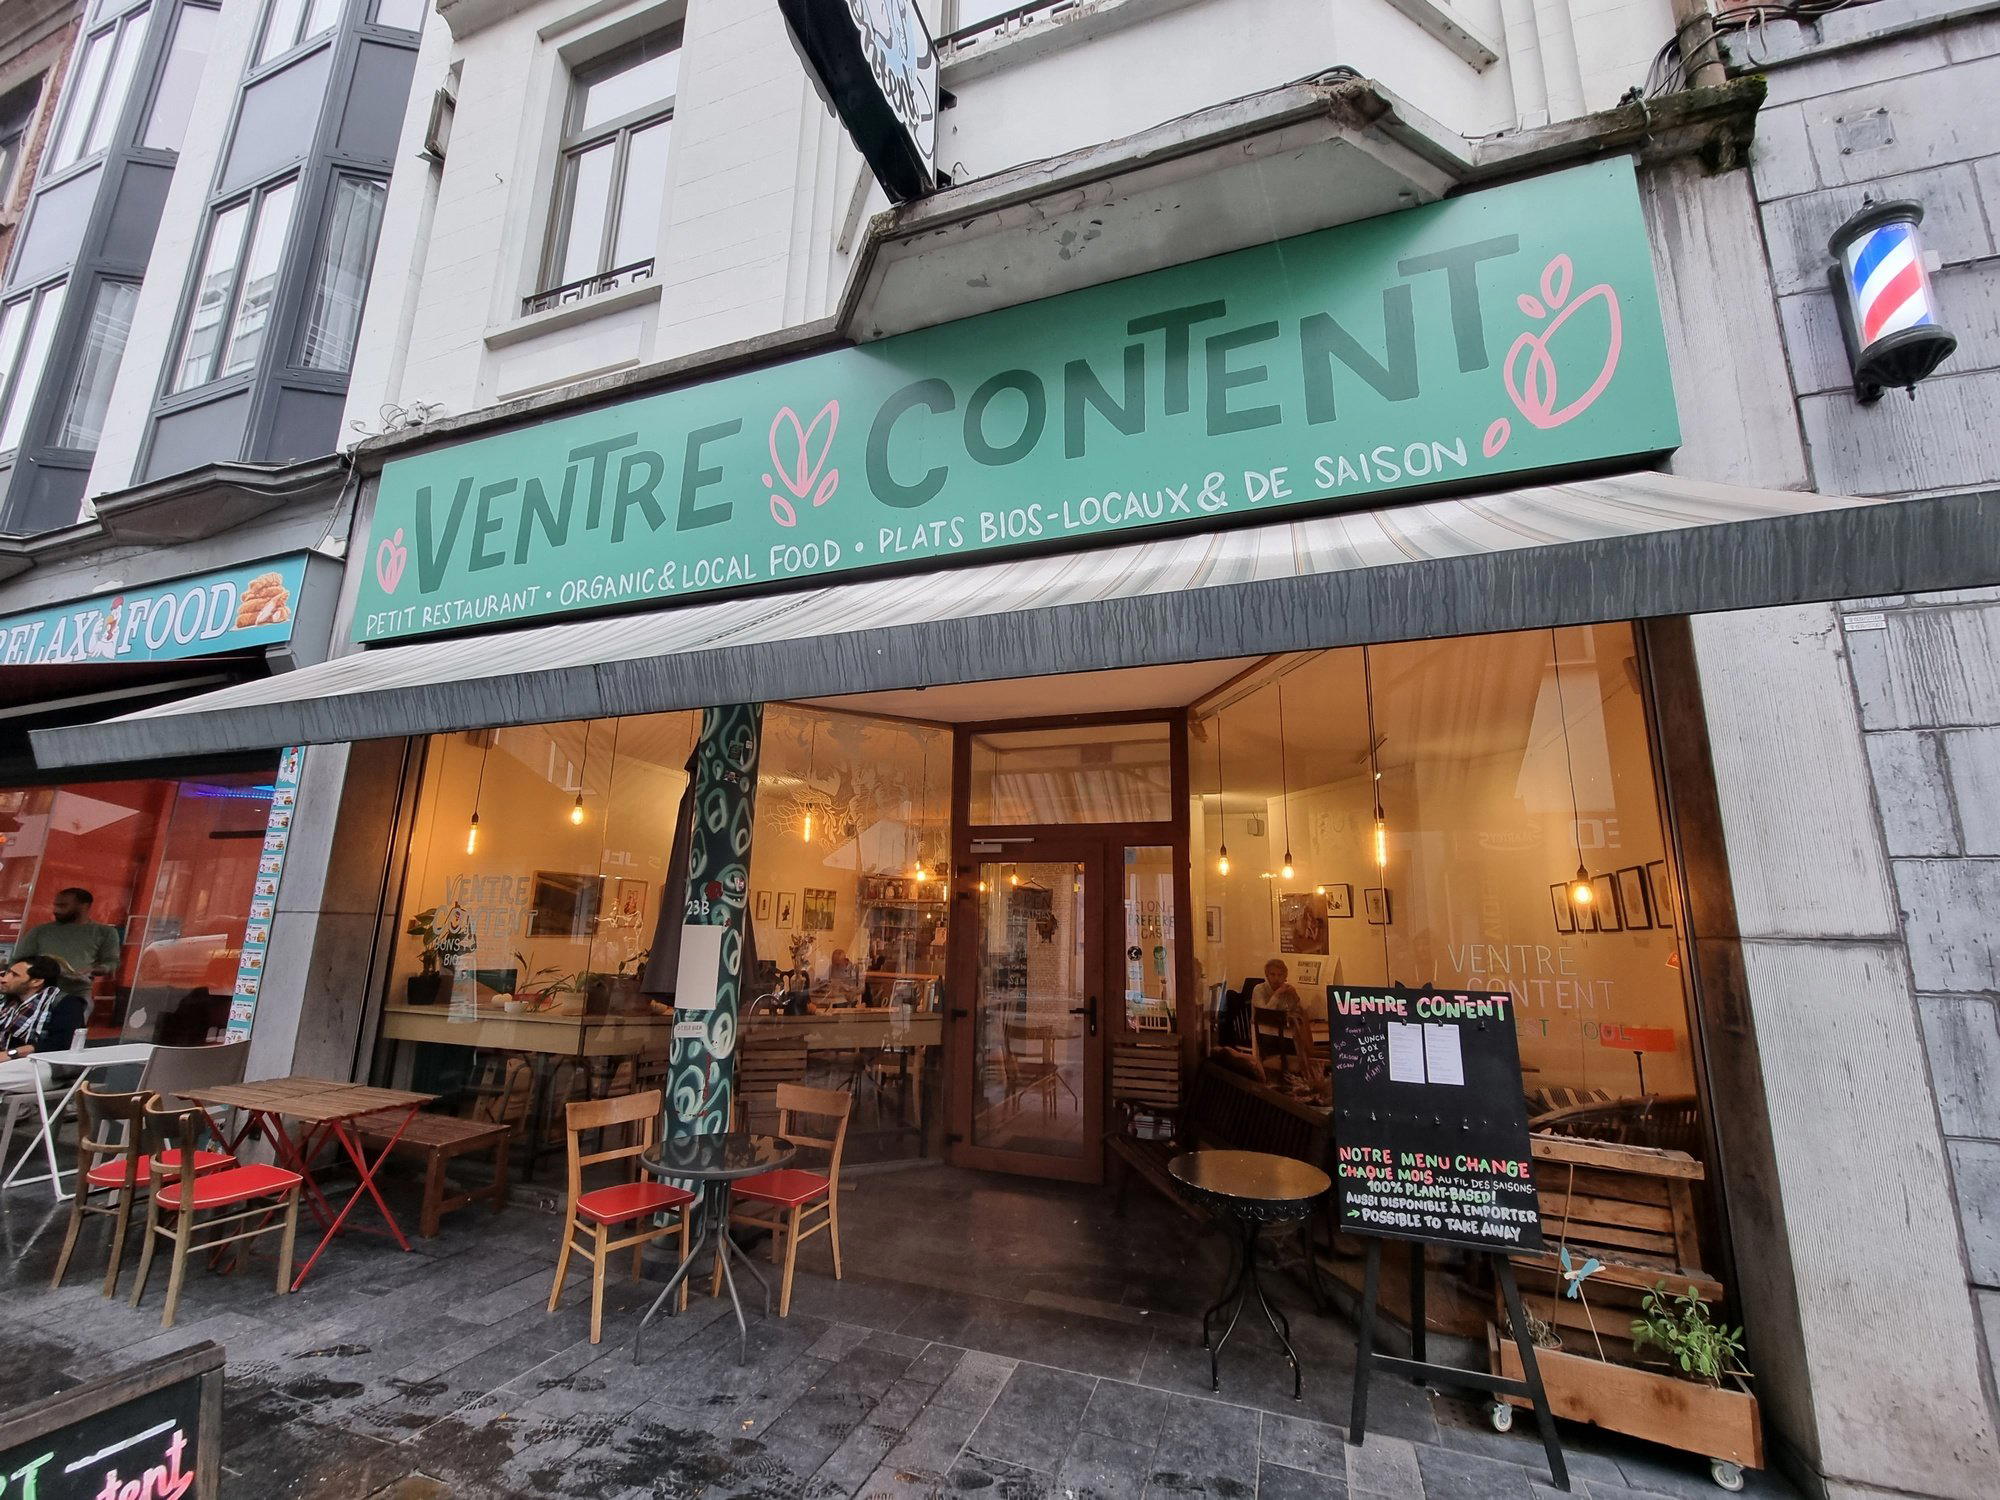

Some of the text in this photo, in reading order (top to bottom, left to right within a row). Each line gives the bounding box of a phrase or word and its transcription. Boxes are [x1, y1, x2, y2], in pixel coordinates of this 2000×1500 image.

[416, 234, 1520, 594] VENTRE CONTENT
[366, 606, 416, 637] PETIT
[423, 585, 540, 628] RESTAURANT
[560, 568, 655, 605] ORGANIC
[682, 554, 757, 588] LOCAL
[769, 539, 841, 577] FOOD
[879, 516, 965, 553] PLATS
[979, 483, 1188, 543] BIOS-LOCAUX
[1244, 467, 1293, 503] DE
[1314, 437, 1468, 489] SAISON
[116, 581, 238, 654] FOOD
[1447, 944, 1578, 976] VENTRE
[1333, 990, 1509, 1022] VENTRE CONTENT
[1358, 1034, 1386, 1046] LUNCH
[1360, 1043, 1379, 1055] BOX
[1338, 1163, 1434, 1185] CHAQUE MOIS
[1339, 1147, 1530, 1179] NOTRE MENU CHANGE
[1366, 1180, 1497, 1205] 100% PLANT-BASED!
[1453, 1177, 1469, 1187] FIL
[1471, 1179, 1491, 1190] DES
[1346, 1191, 1379, 1207] AUSSI
[1380, 1196, 1448, 1213] DISPONIBLE
[1463, 1204, 1538, 1224] EMPORTER
[1361, 1207, 1522, 1243] POSSIBLE TO TAKE AWAY
